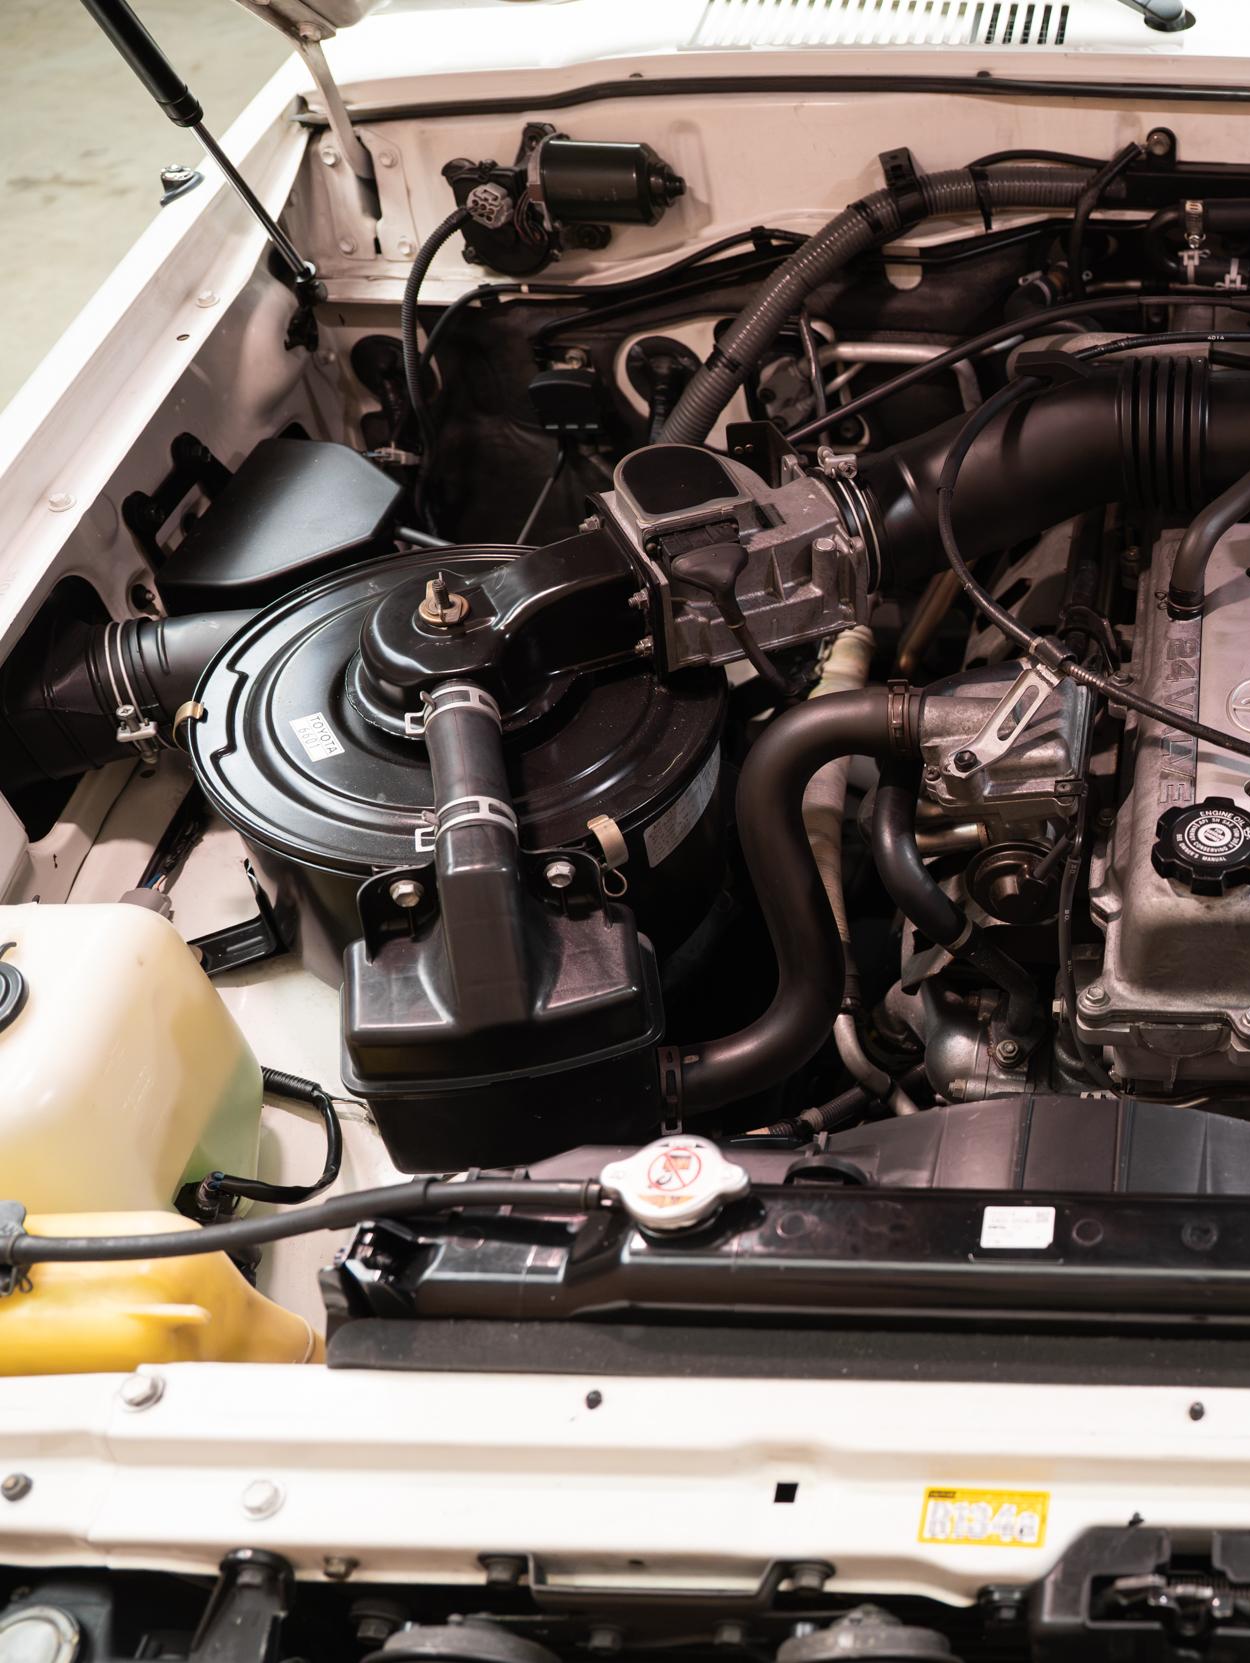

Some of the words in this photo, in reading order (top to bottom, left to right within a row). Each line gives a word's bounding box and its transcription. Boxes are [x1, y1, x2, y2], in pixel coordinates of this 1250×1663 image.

[310, 715, 338, 754] TOYOTA
[1199, 810, 1234, 819] ENGINE
[1233, 815, 1246, 827] OIL
